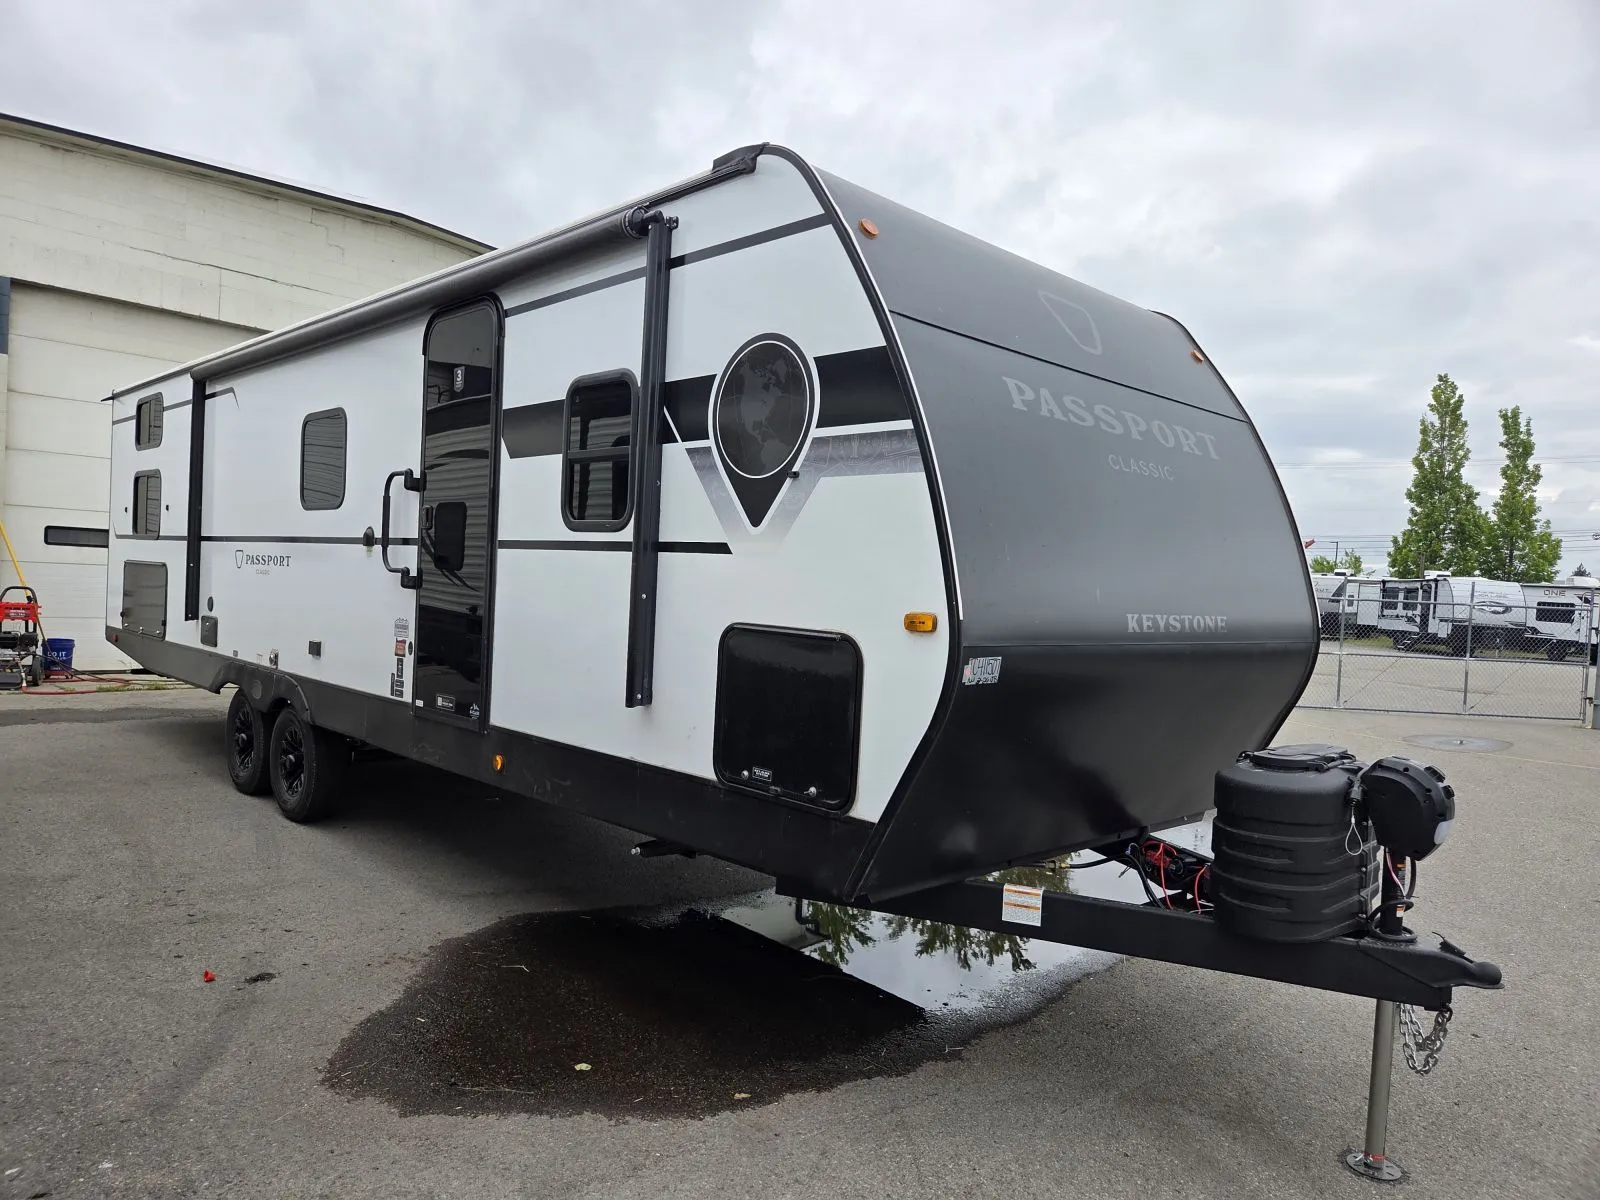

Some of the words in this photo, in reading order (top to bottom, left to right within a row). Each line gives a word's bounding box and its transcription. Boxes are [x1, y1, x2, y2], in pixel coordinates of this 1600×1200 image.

[1001, 375, 1221, 460] PASSPORT
[1108, 453, 1176, 481] CLASSIC
[245, 554, 291, 567] PASSPORT
[1126, 613, 1228, 633] KEYSTONE
